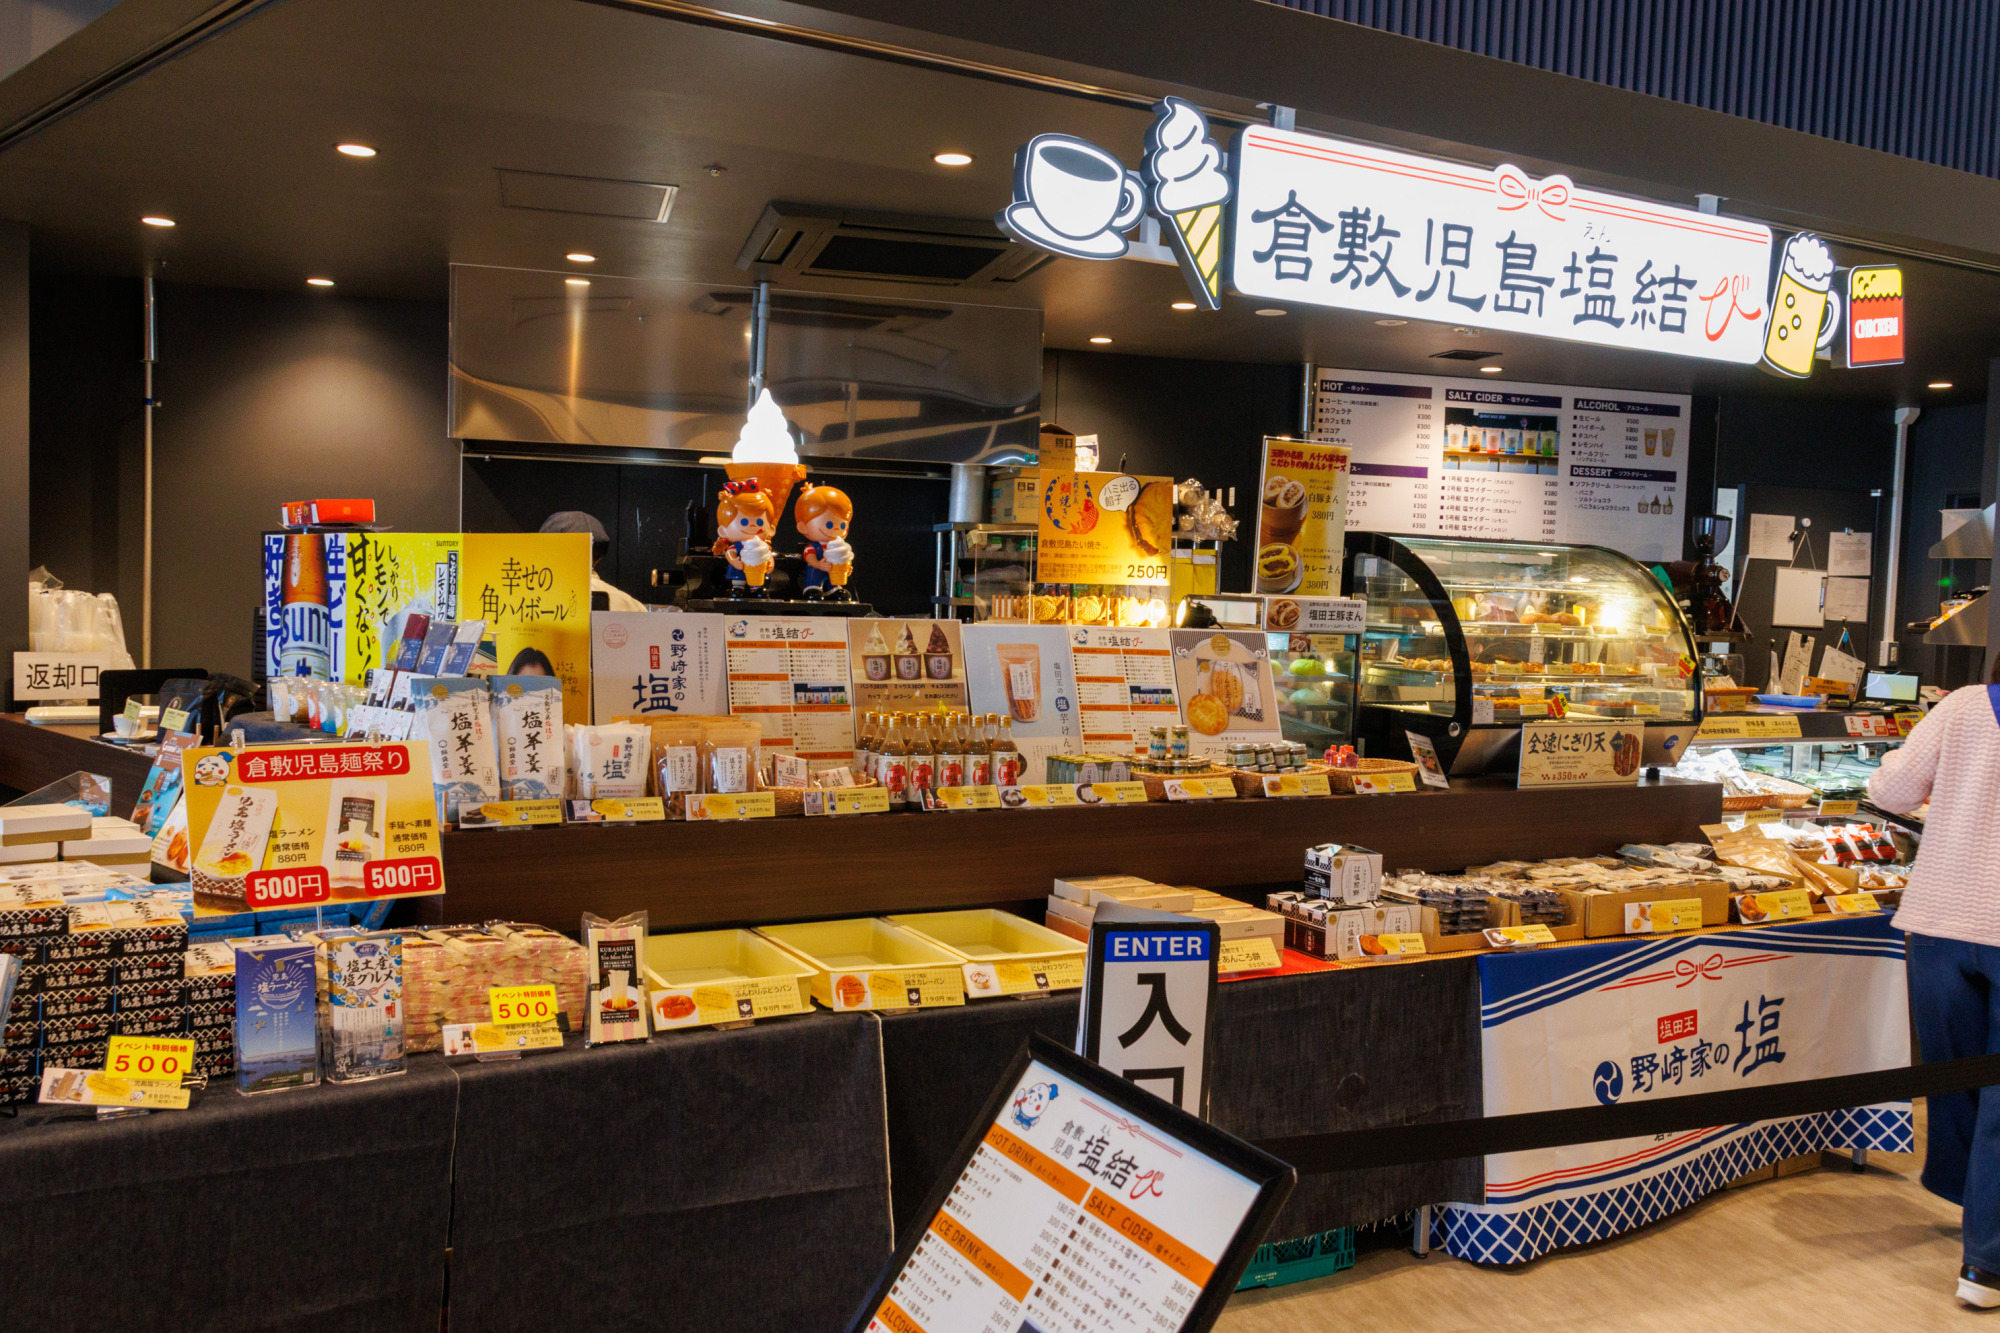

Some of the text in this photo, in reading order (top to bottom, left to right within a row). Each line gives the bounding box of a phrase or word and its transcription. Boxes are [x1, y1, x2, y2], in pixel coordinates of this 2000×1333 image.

[1251, 189, 1762, 341] 倉敷児島塩結び
[1854, 317, 1899, 340] CHICKEN
[1323, 382, 1343, 390] HOT
[1448, 391, 1503, 402] SALT CIDER
[1577, 401, 1620, 411] ALCOHOL
[1573, 467, 1612, 477] DESSERT
[1104, 480, 1136, 495] ハミ出る
[1309, 492, 1340, 504] 白豚まん
[1312, 511, 1334, 521] 380円
[388, 545, 399, 602] しっかり
[501, 557, 553, 595] 幸せの
[1127, 564, 1167, 579] 250円
[1303, 564, 1341, 574] カレーまん
[374, 540, 388, 626] レモンで
[1307, 580, 1329, 590] 380円
[480, 584, 569, 624] 角ハイボール
[1309, 610, 1363, 622] 塩田王豚まん
[772, 627, 814, 639] 塩結び
[26, 663, 99, 690] 返却口
[632, 673, 678, 713] 塩
[1528, 732, 1606, 755] 全速にぎり天
[245, 751, 403, 779] 倉敷児島麺祭り
[269, 827, 315, 839] 塩ラーメン
[388, 819, 431, 830] 手延べ素麺
[392, 832, 427, 843] 通常価格
[271, 842, 310, 853] 通常価格
[397, 843, 425, 853] 680円
[277, 853, 307, 864] 880円
[371, 864, 435, 889] 500円
[254, 874, 323, 900] 500円
[1114, 937, 1202, 957] ENTER
[257, 980, 302, 993] 塩ラーメン
[342, 970, 393, 987] 塩グルメ
[905, 978, 945, 986] 焼きカレーパン
[494, 990, 551, 999] イベント特別価格
[735, 985, 792, 997] ふんわりぶどうパン
[1660, 1015, 1695, 1039] 塩田王
[114, 1042, 188, 1053] イベント特別価格
[988, 1129, 1009, 1148] HOT
[1007, 1141, 1036, 1167] DRINK
[1051, 1137, 1075, 1160] 児島
[981, 1150, 1005, 1169] コーヒー
[1061, 1120, 1165, 1200] 倉敷 塩結び
[972, 1163, 1001, 1186] カフェラテ
[957, 1189, 975, 1204] ココア
[965, 1176, 993, 1198] カフェモカ
[1087, 1194, 1116, 1220] SALT
[1119, 1215, 1154, 1245] CIDER
[934, 1216, 953, 1236] ICE
[950, 1228, 982, 1260] DRINK
[929, 1238, 965, 1270] アイスコーヒー
[920, 1250, 962, 1287] アイスカフェラテ
[903, 1277, 935, 1305] アイスココア
[1169, 1278, 1196, 1303] 380円
[1160, 1294, 1187, 1319] 380円
